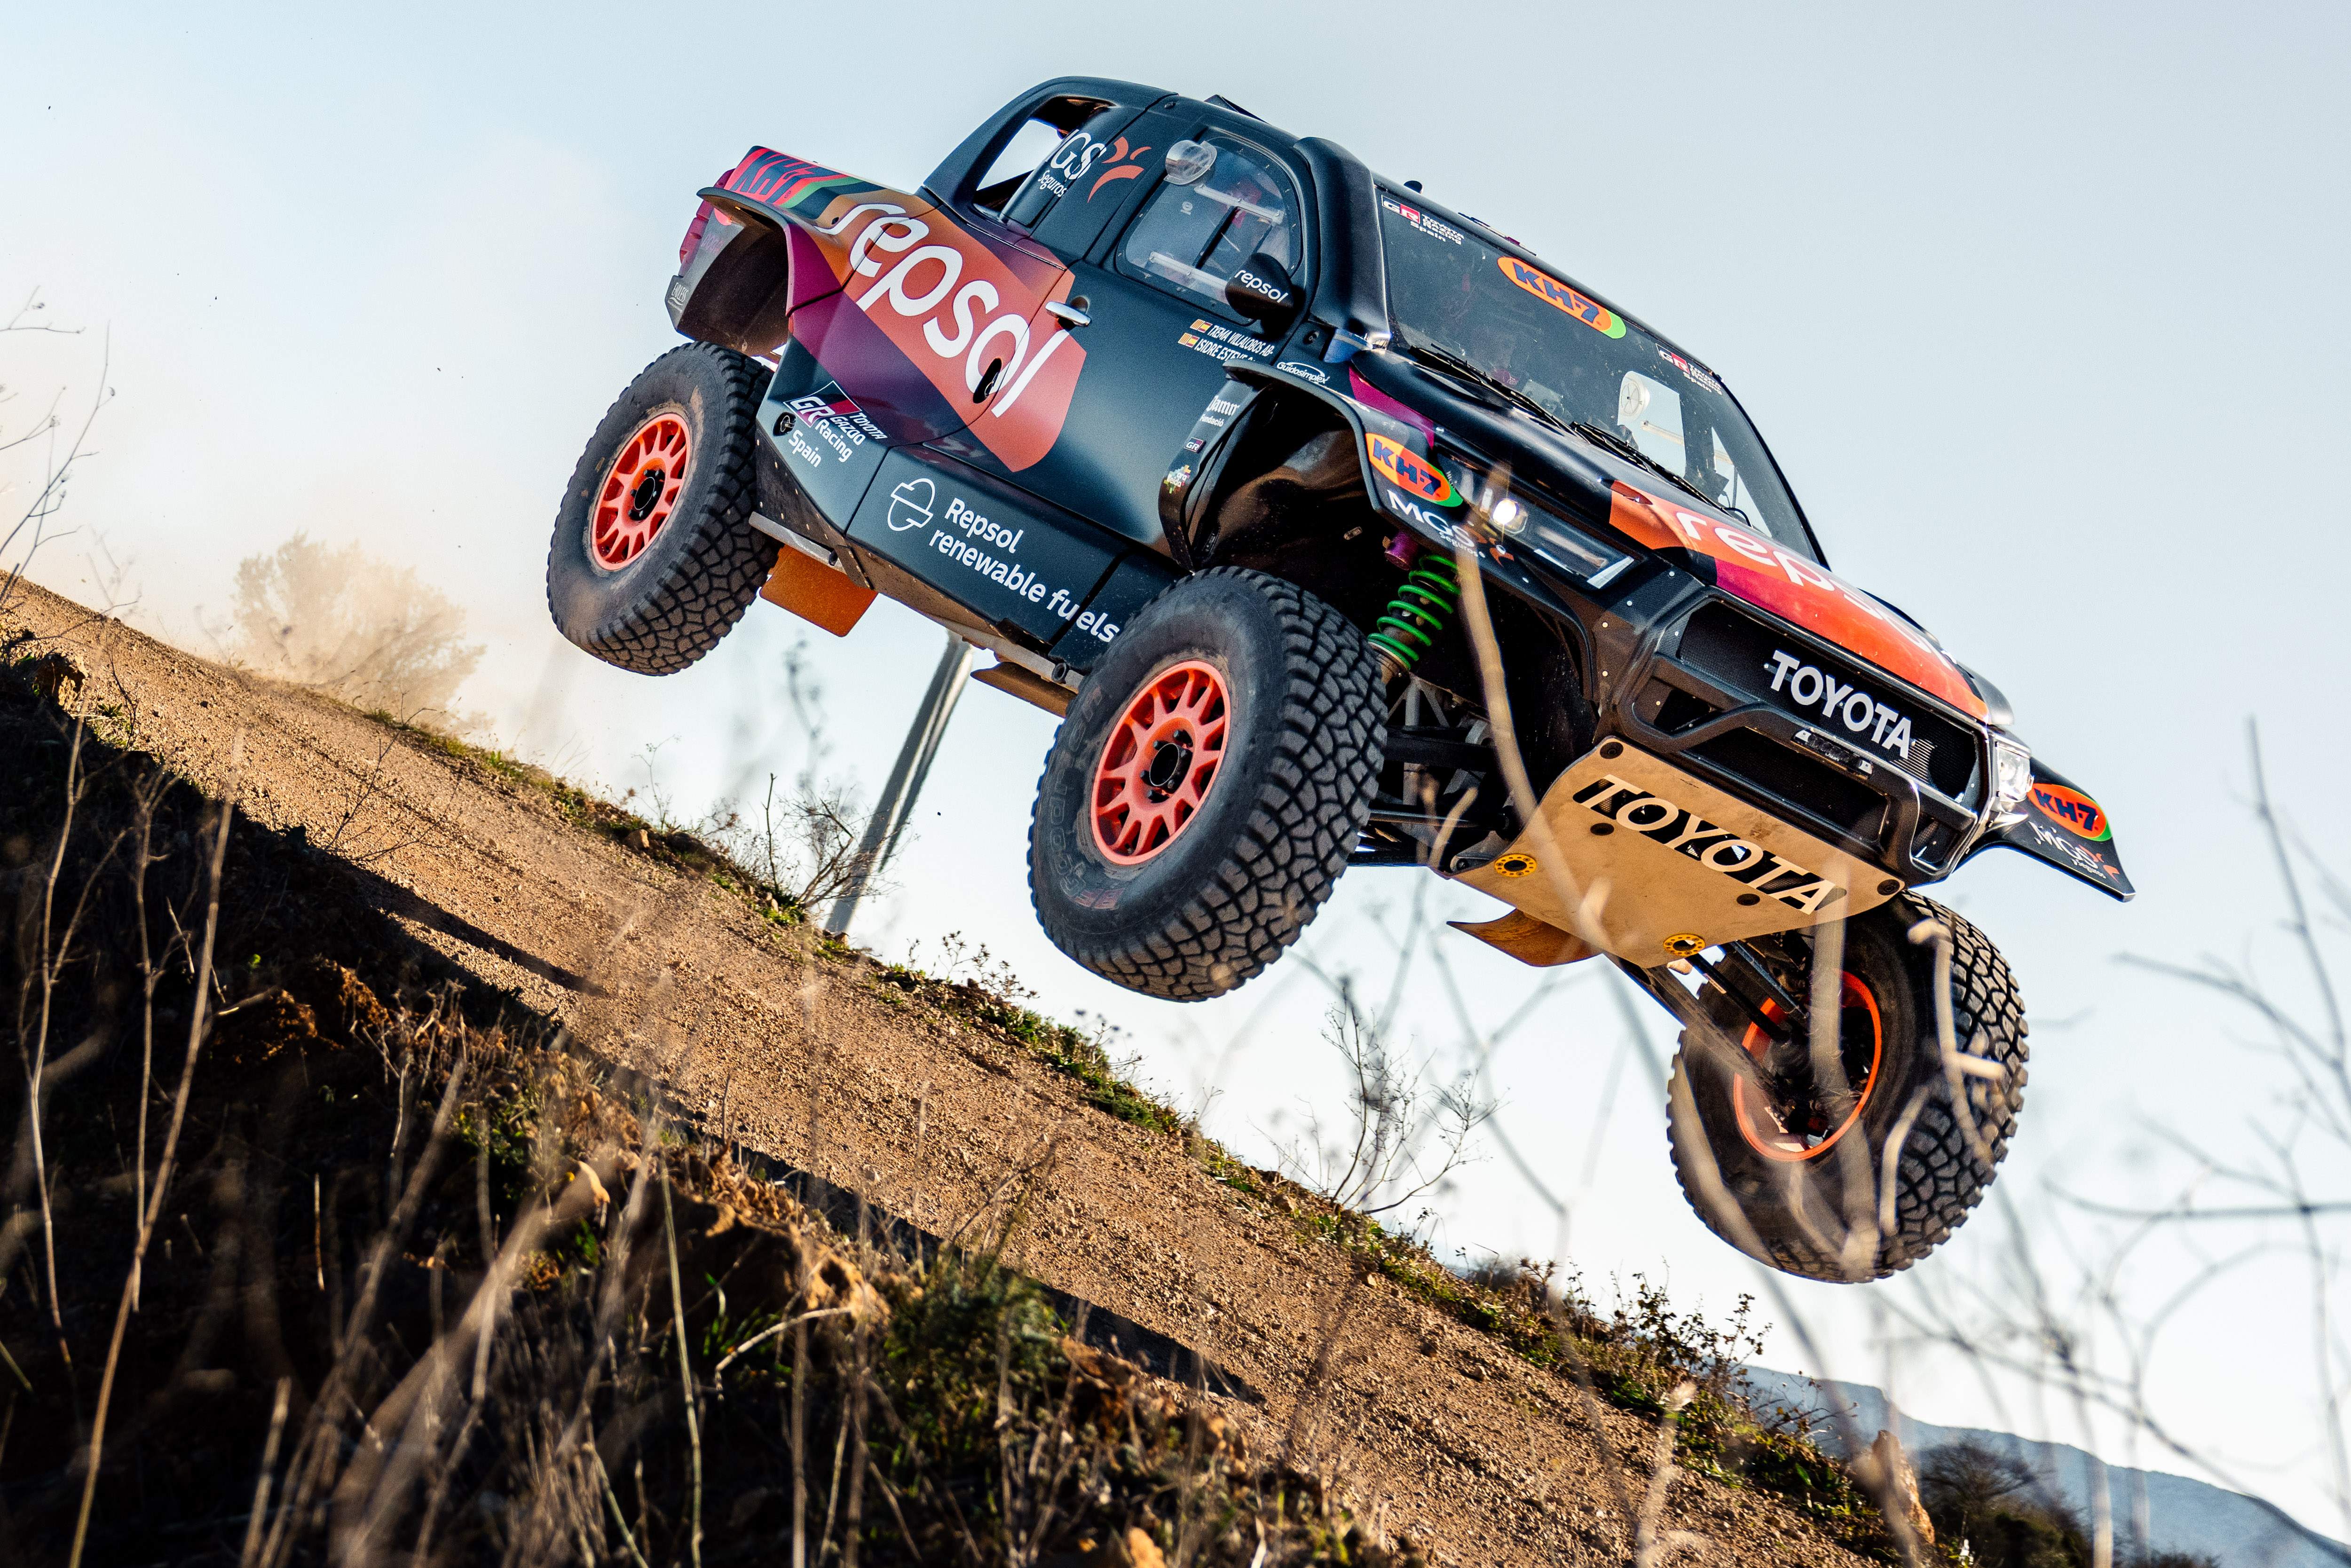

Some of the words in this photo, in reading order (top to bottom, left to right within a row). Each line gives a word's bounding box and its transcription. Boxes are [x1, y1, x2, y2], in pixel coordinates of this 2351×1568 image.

[1038, 170, 1067, 197] Seguros
[1383, 201, 1419, 223] GR
[1411, 221, 1446, 242] Spain
[1422, 214, 1465, 240] TOYOTA
[1423, 219, 1462, 241] GAZOO
[1423, 222, 1461, 245] Racing
[1234, 270, 1288, 303] repsol
[815, 204, 1071, 418] repsol
[1194, 339, 1223, 357] ISIDRE
[1207, 325, 1232, 342] TXEMA
[1227, 332, 1266, 354] VILLALOBOS
[1277, 362, 1329, 384] Guidosimplex
[790, 396, 836, 424] GR
[1199, 414, 1225, 427] Fundació
[829, 416, 866, 446] GAZOO
[849, 412, 888, 440] TOYOTA
[788, 430, 821, 468] Spain
[815, 419, 853, 463] Racing
[1186, 441, 1200, 451] GR
[944, 497, 1024, 554] Repsol
[1387, 489, 1475, 547] MGS
[929, 529, 1046, 602] renewable
[1046, 589, 1120, 643] fuels
[1770, 650, 1911, 760] TOYOTA
[1580, 774, 1837, 915] TOYOTA
